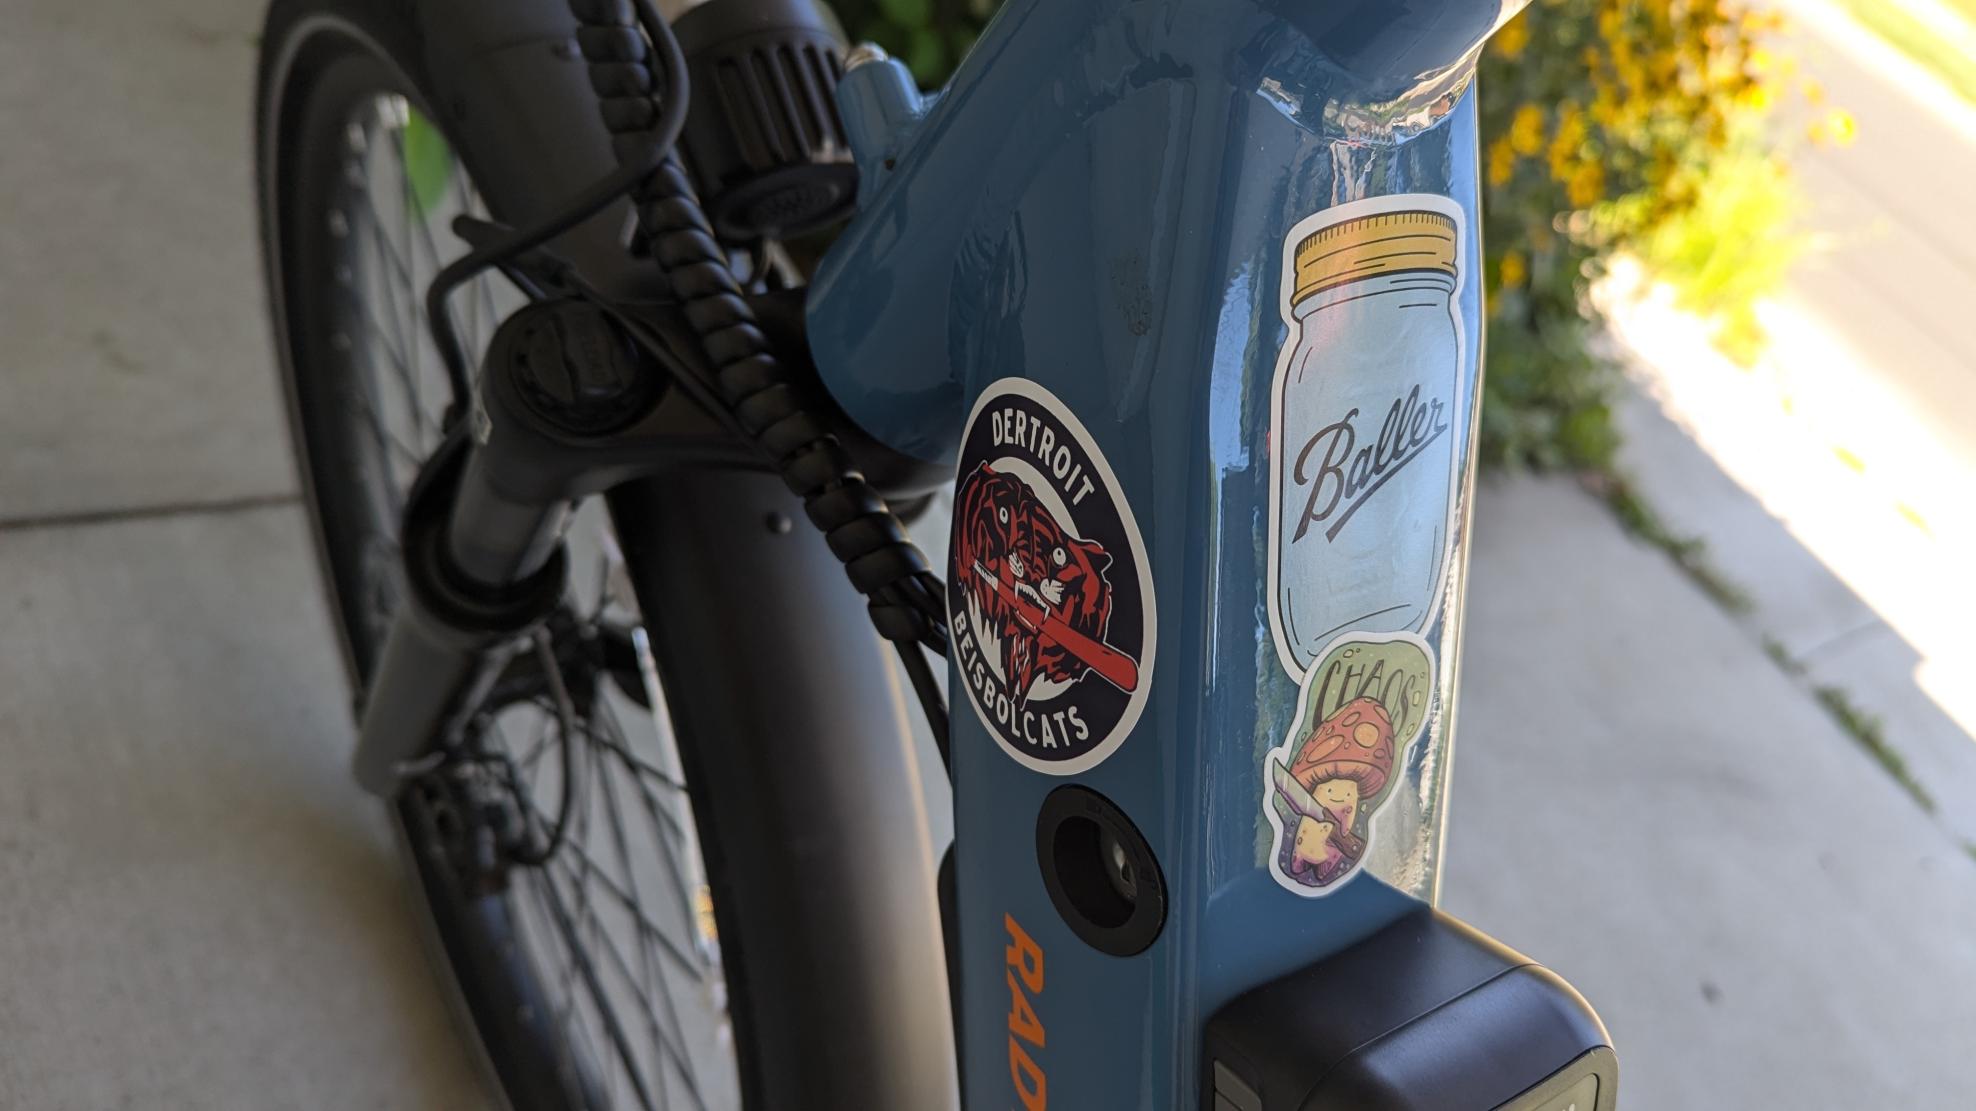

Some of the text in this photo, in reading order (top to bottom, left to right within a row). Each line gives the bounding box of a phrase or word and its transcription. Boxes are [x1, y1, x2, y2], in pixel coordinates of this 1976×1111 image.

[992, 408, 1094, 506] DERTROIT
[1292, 384, 1448, 544] Baller
[954, 611, 1089, 749] BEISBOLCATS
[1312, 659, 1416, 737] CHAOS
